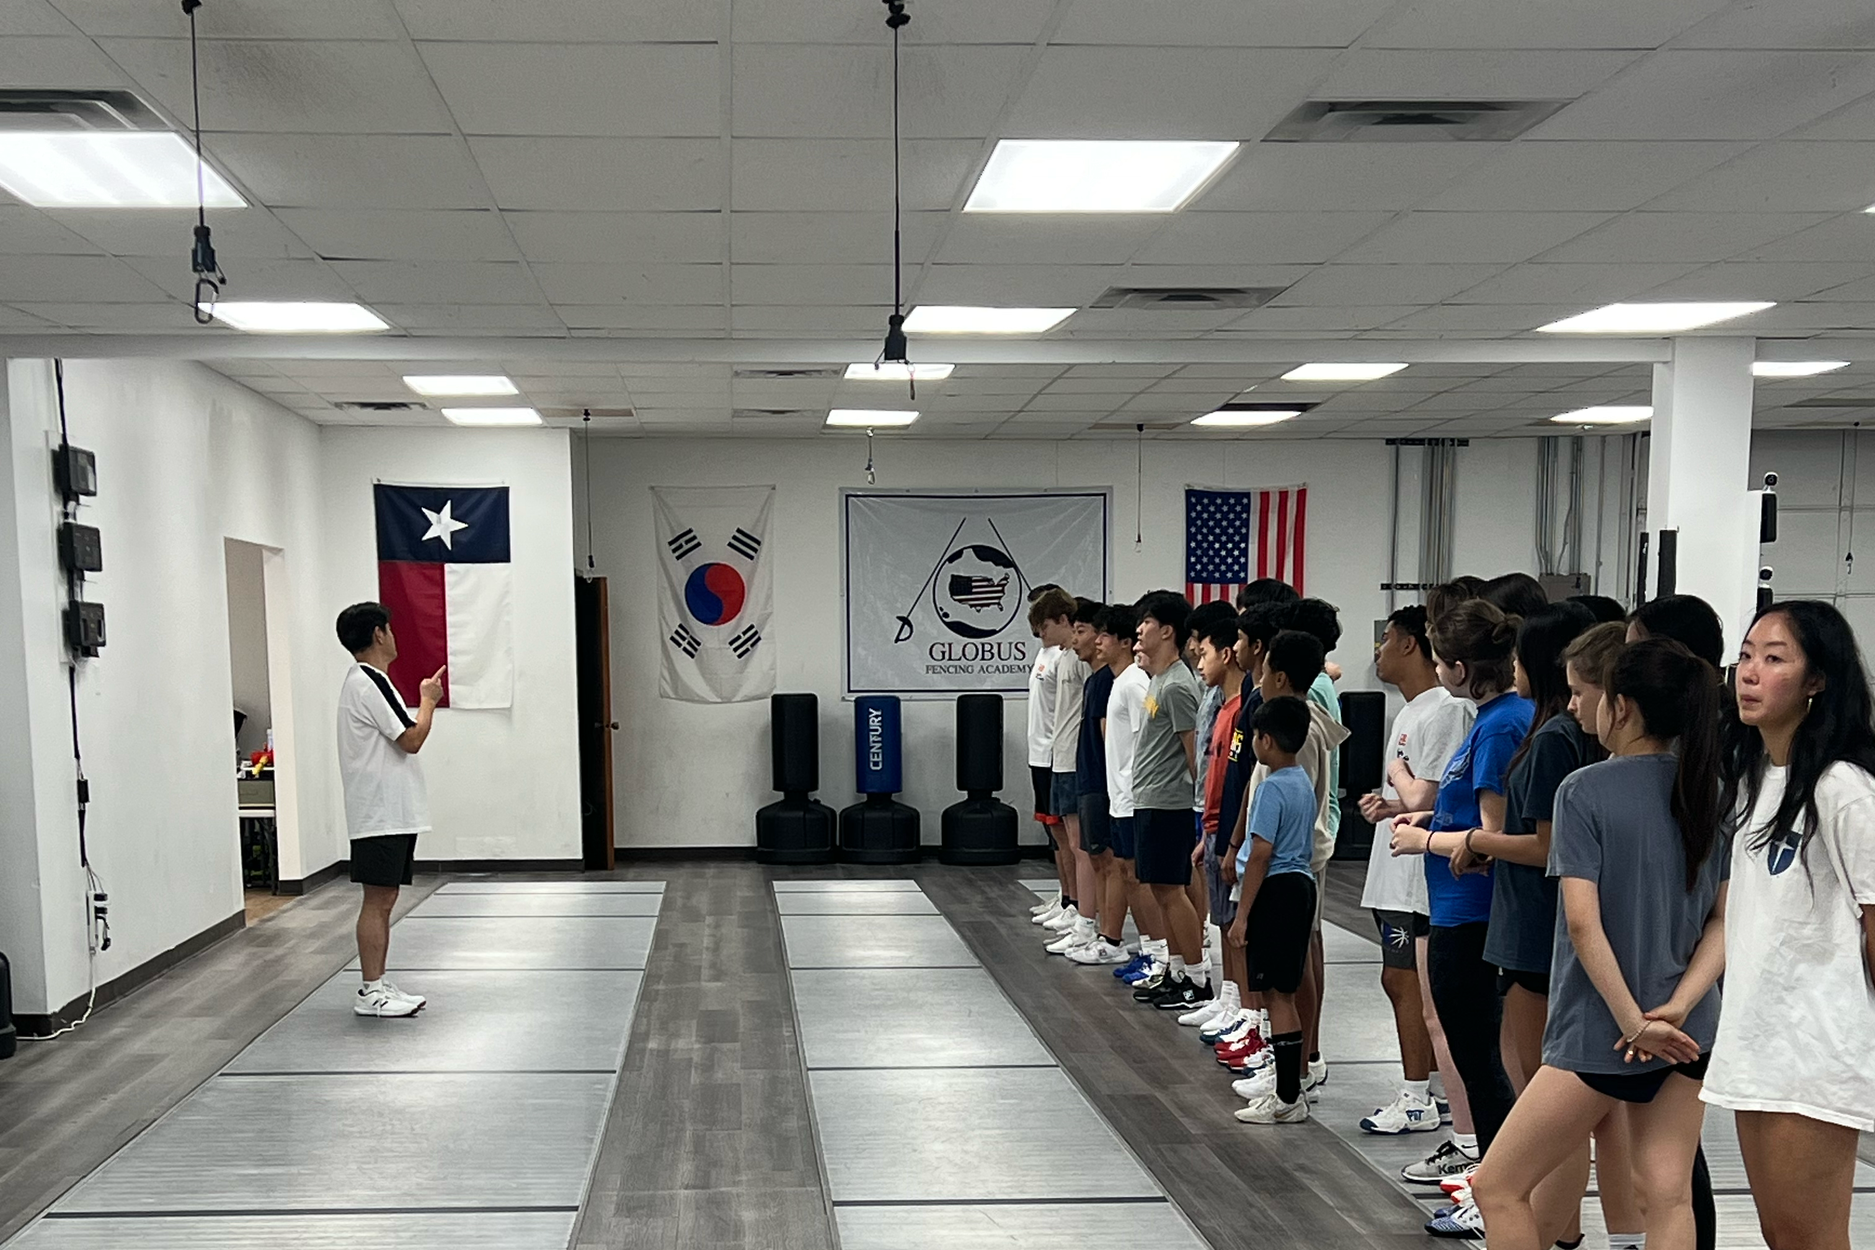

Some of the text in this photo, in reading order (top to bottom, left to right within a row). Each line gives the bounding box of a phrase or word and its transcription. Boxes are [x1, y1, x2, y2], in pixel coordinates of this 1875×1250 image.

[928, 641, 1027, 662] GLOBUS
[925, 664, 975, 675] FENCING
[977, 663, 1034, 675] ACADEMY
[869, 708, 882, 771] CENTURY
